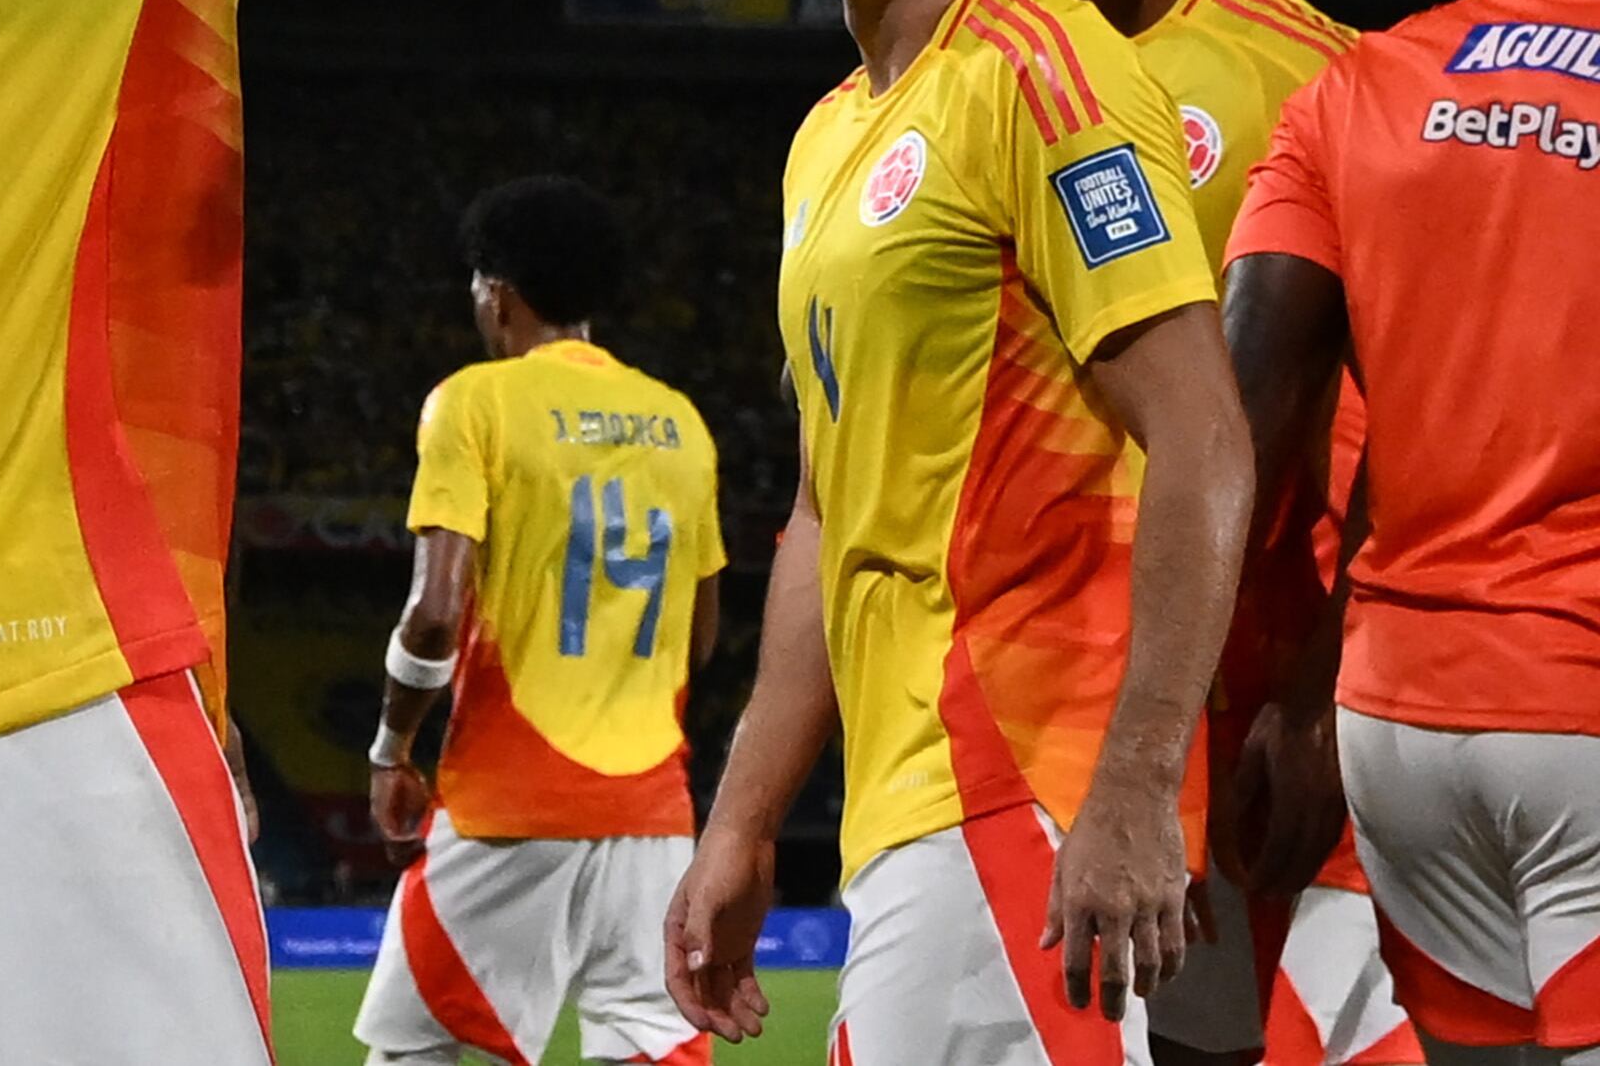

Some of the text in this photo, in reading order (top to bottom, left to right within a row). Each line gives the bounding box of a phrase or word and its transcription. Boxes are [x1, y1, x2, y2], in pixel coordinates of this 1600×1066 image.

[1453, 23, 1600, 82] AGUIL
[1422, 100, 1600, 169] BetPlay
[1080, 179, 1133, 212] UNITES
[558, 473, 671, 658] 14
